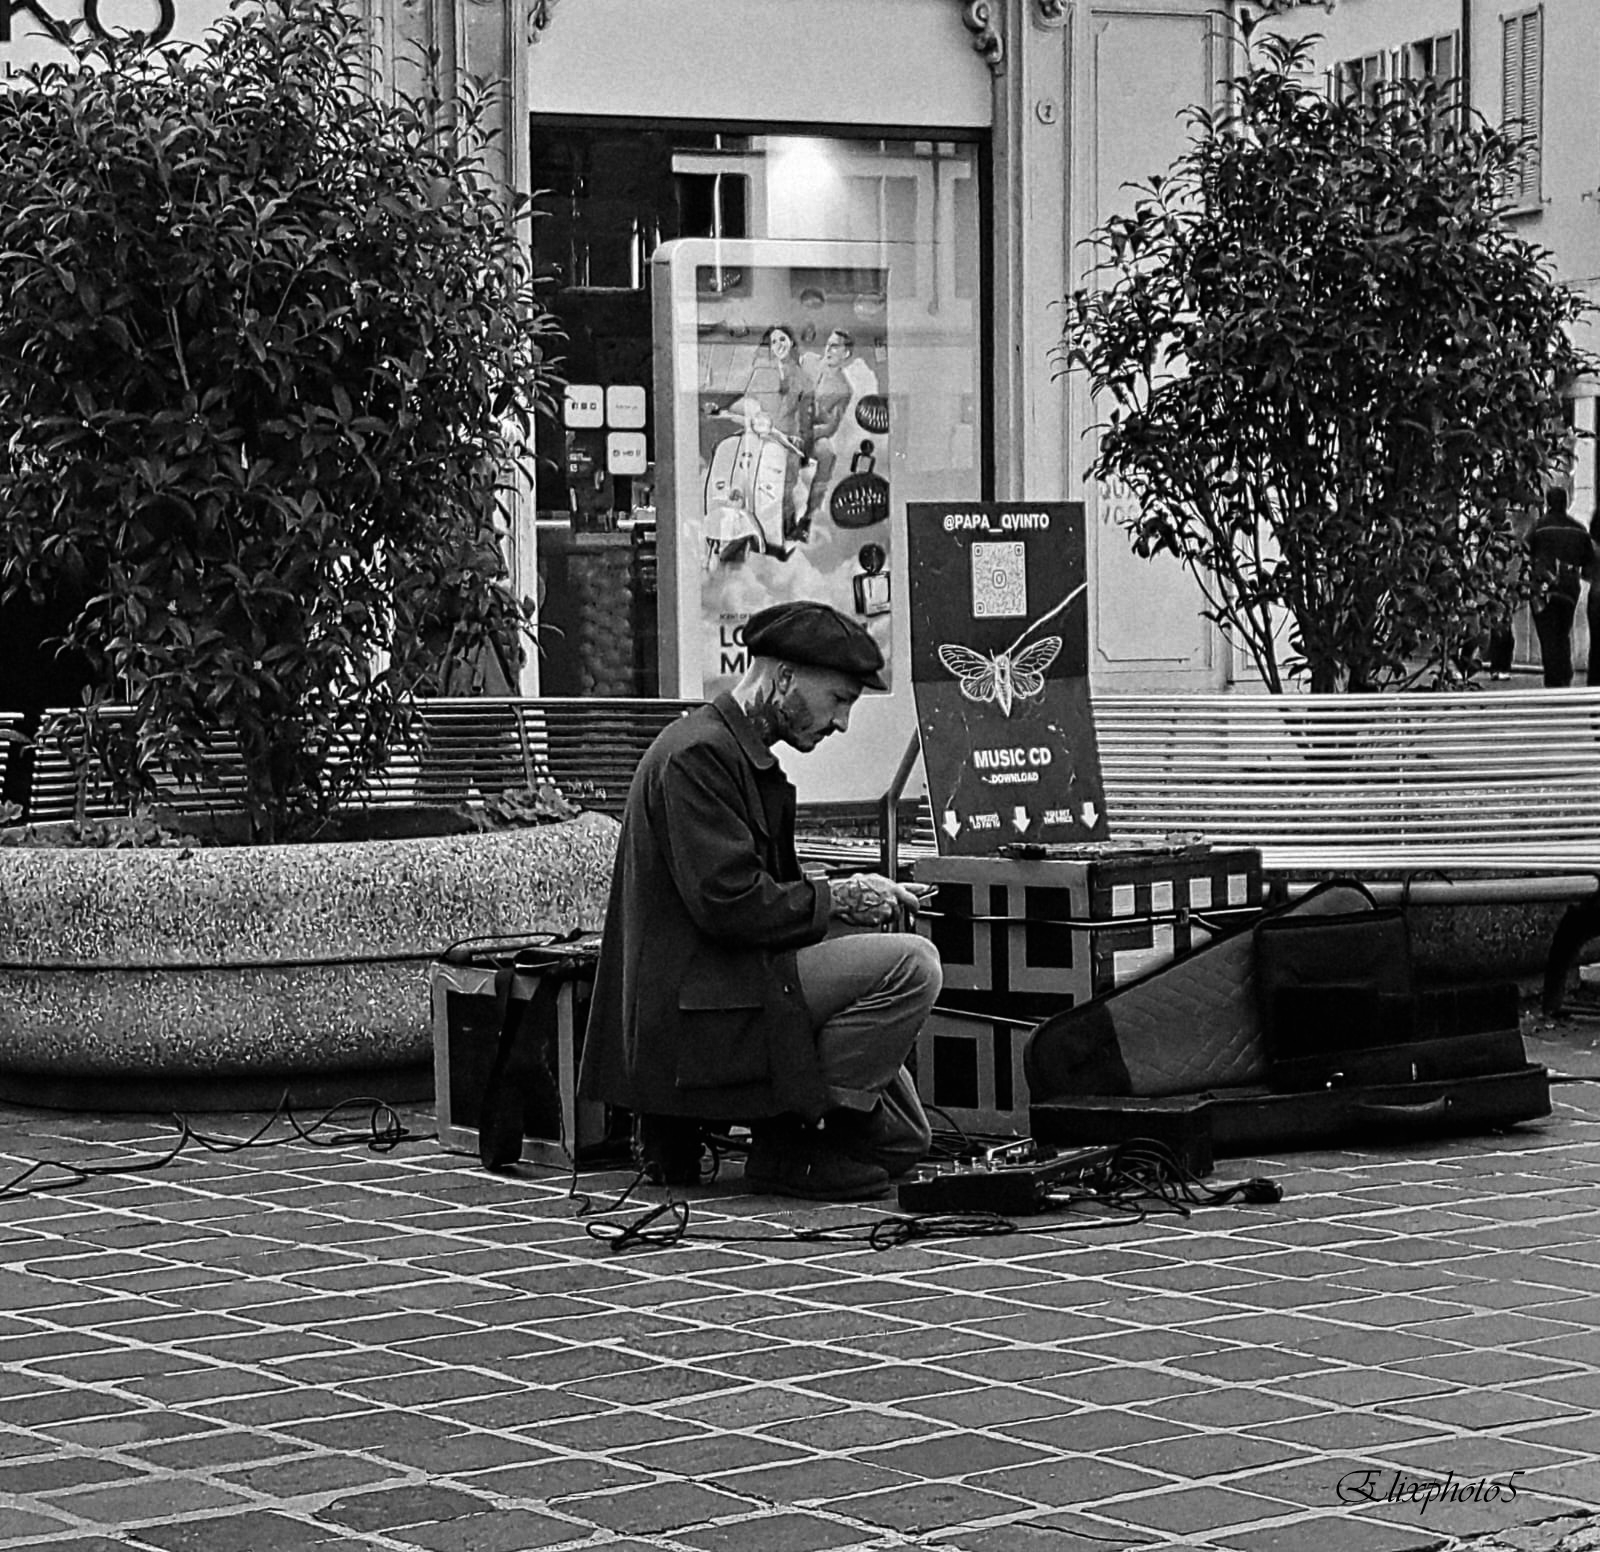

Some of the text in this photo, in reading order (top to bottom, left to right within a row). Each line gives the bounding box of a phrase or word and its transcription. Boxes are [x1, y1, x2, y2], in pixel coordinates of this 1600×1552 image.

[943, 513, 1050, 533] @PAPA_QVINTO
[973, 747, 1052, 768] MUSIC CD
